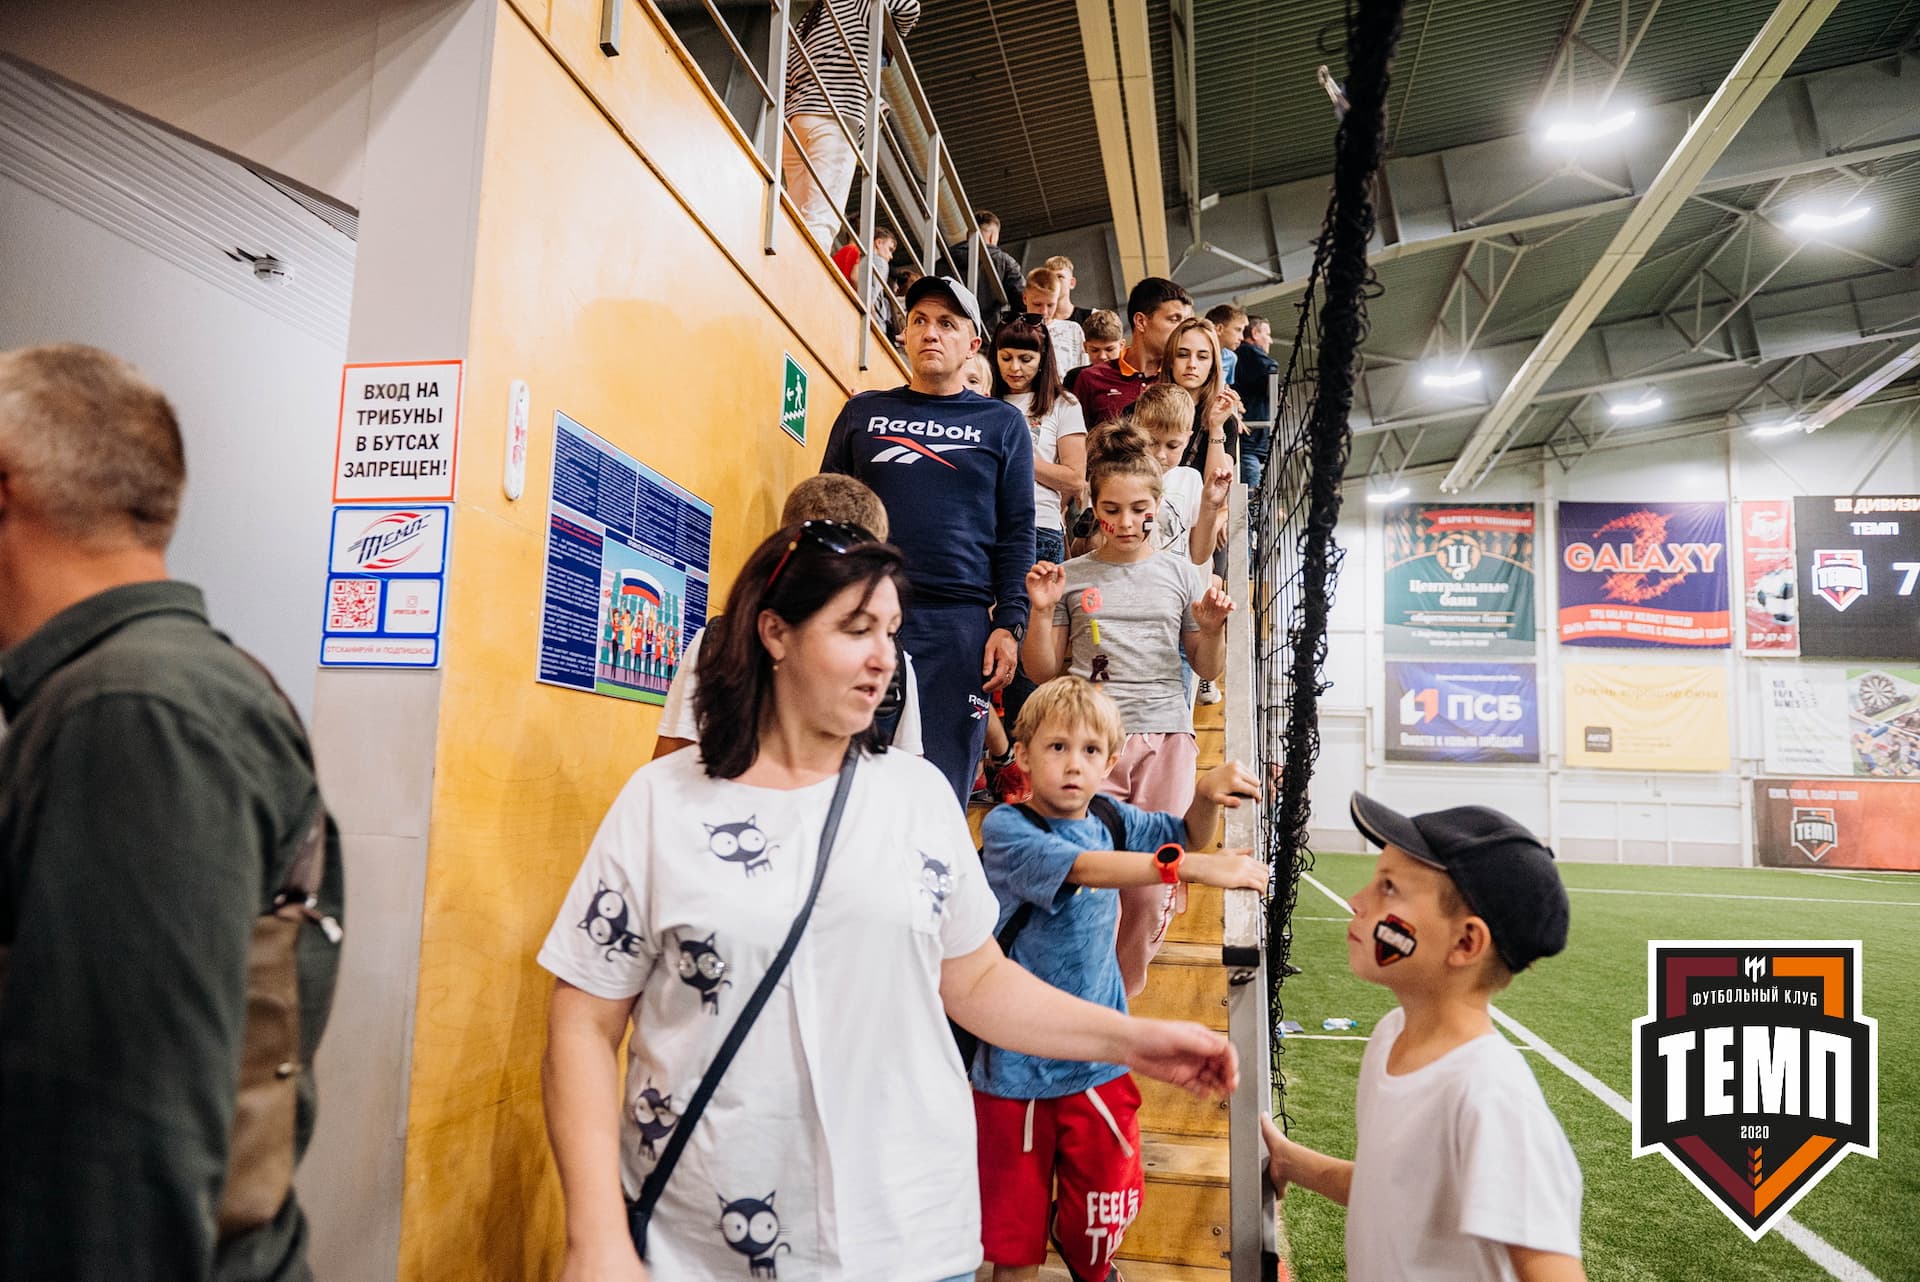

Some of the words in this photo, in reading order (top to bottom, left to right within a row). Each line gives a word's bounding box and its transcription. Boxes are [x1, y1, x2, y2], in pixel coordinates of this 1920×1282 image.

[364, 383, 410, 401] ВХОД
[416, 382, 439, 398] НА
[357, 408, 443, 426] ТРИБУНЫ
[867, 416, 982, 443] Reebok
[356, 436, 367, 451] В
[373, 434, 440, 451] БУТСАХ
[344, 459, 447, 480] ЗАПРЕЩЕН!
[1850, 522, 1899, 535] ТЕМП
[1564, 542, 1722, 573] GALAXY
[1409, 579, 1509, 594] Центральные
[1893, 562, 1920, 595] 7
[1447, 694, 1523, 721] ПСБ
[1796, 823, 1833, 842] ТЕМП
